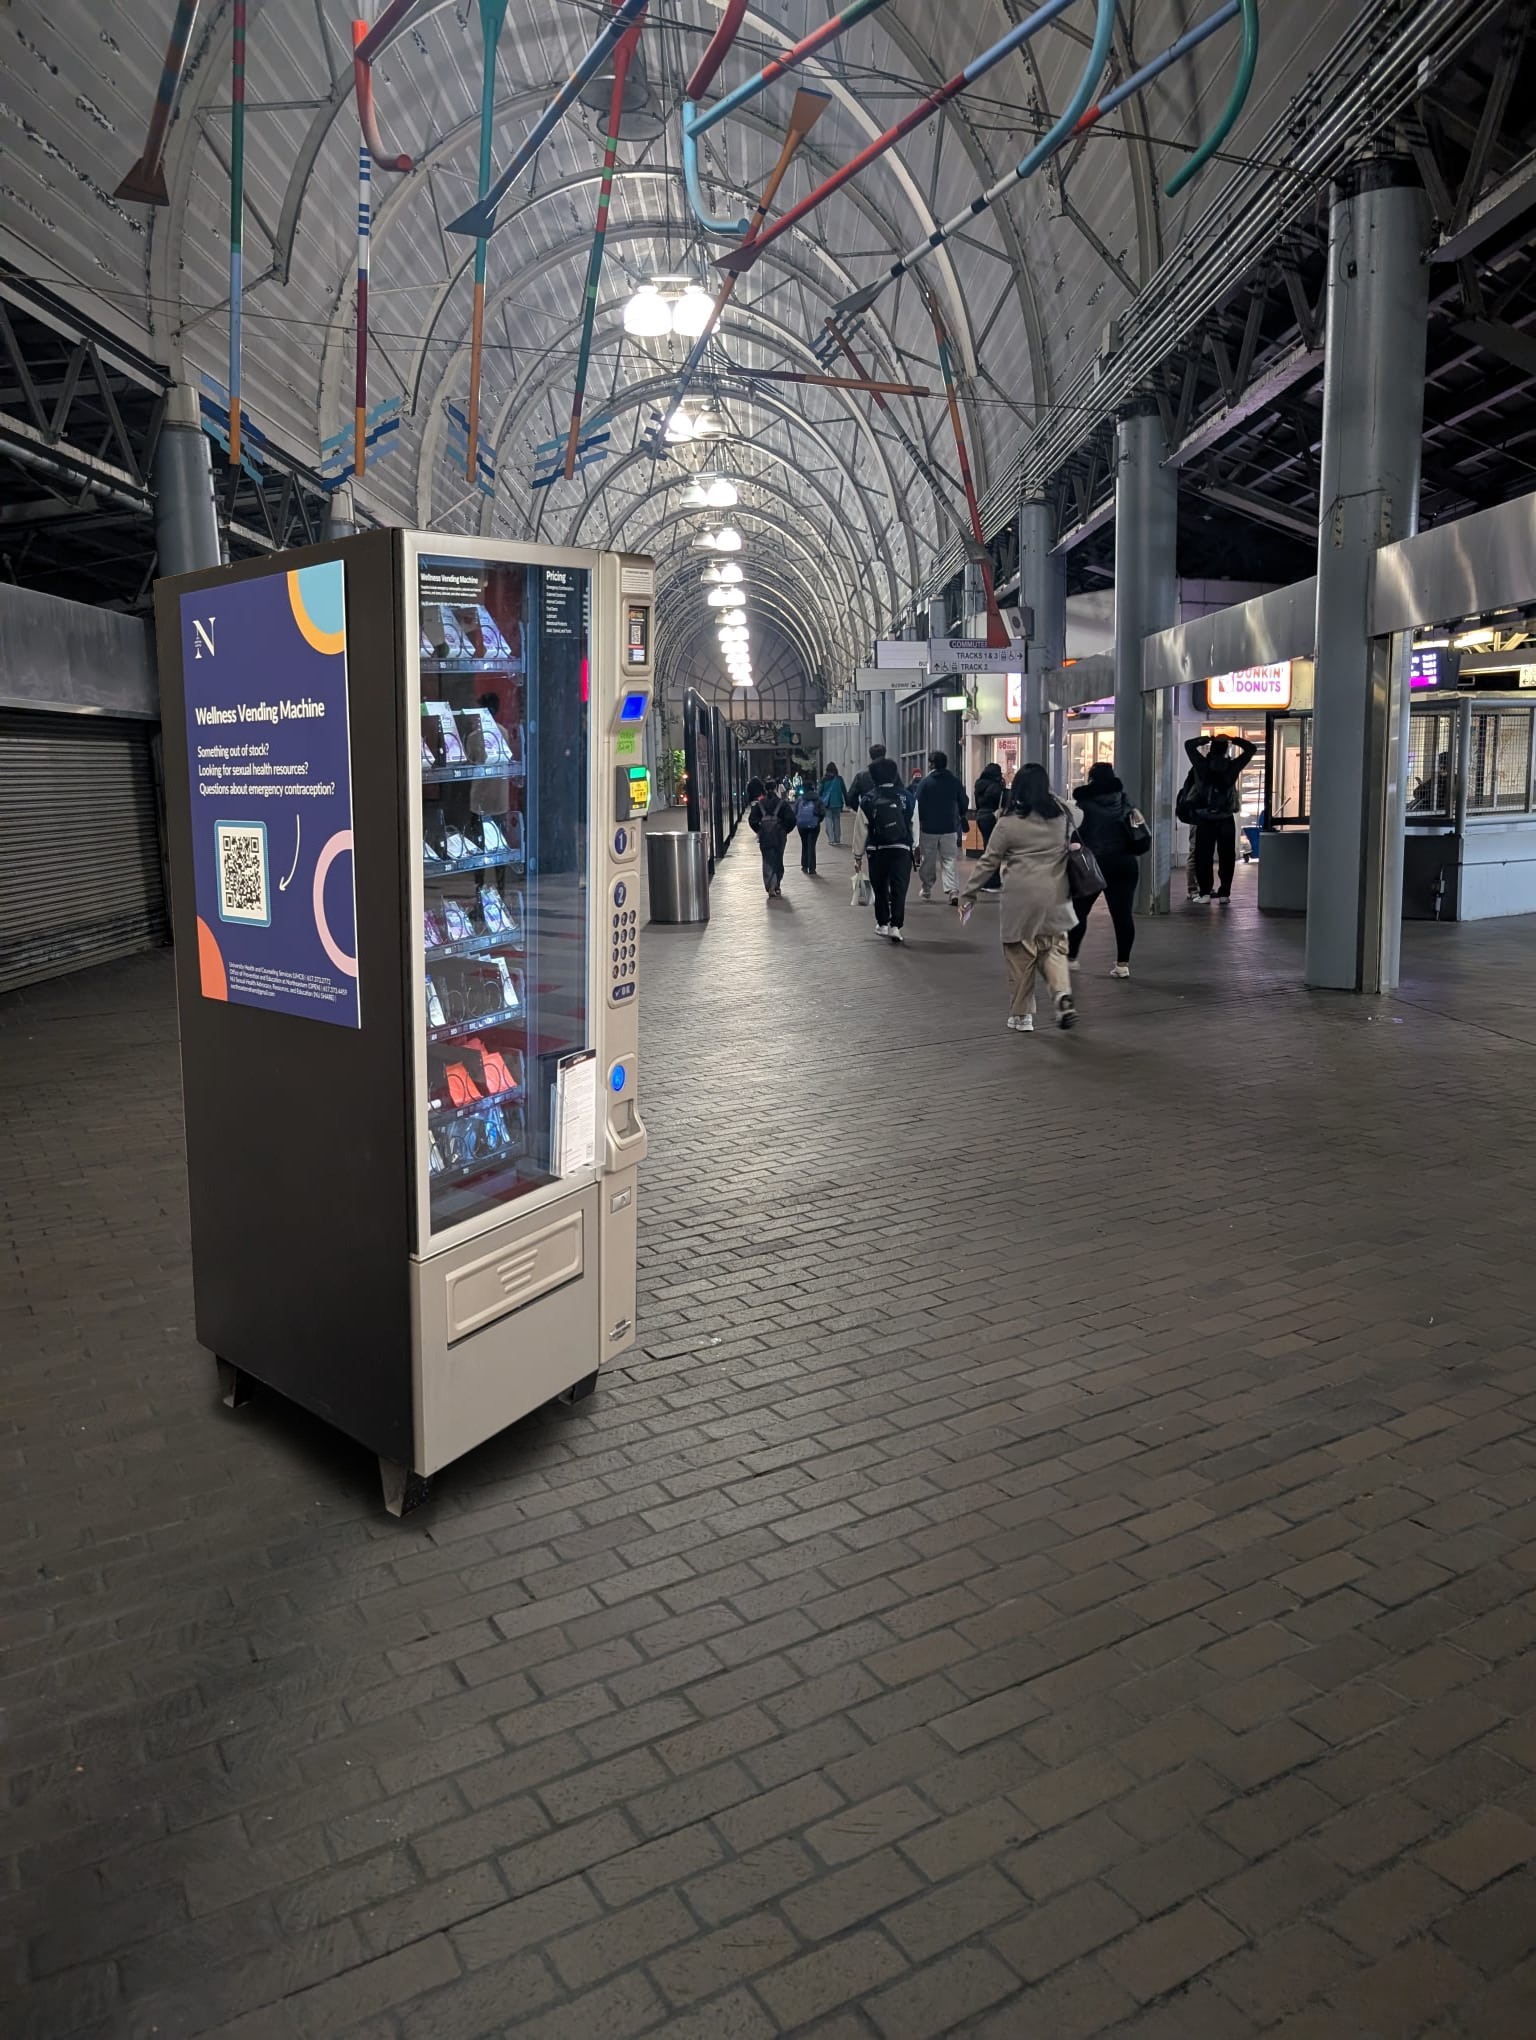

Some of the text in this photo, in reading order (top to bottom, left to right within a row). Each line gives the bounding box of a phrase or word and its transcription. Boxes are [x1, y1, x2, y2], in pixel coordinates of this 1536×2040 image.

[546, 570, 567, 584] Pricing
[956, 652, 998, 660] TRACKS 1 & 3
[960, 663, 988, 671] TRACK 2
[1236, 681, 1281, 692] DONUTS
[195, 697, 325, 726] Wellness Vending Machine
[197, 742, 270, 760] Something out of stock?
[198, 761, 309, 779] Looking for sexual health resources?
[199, 781, 336, 798] Questions about emergency contraception?
[618, 832, 624, 850] 1
[618, 886, 624, 904] 2
[621, 985, 631, 996] OK
